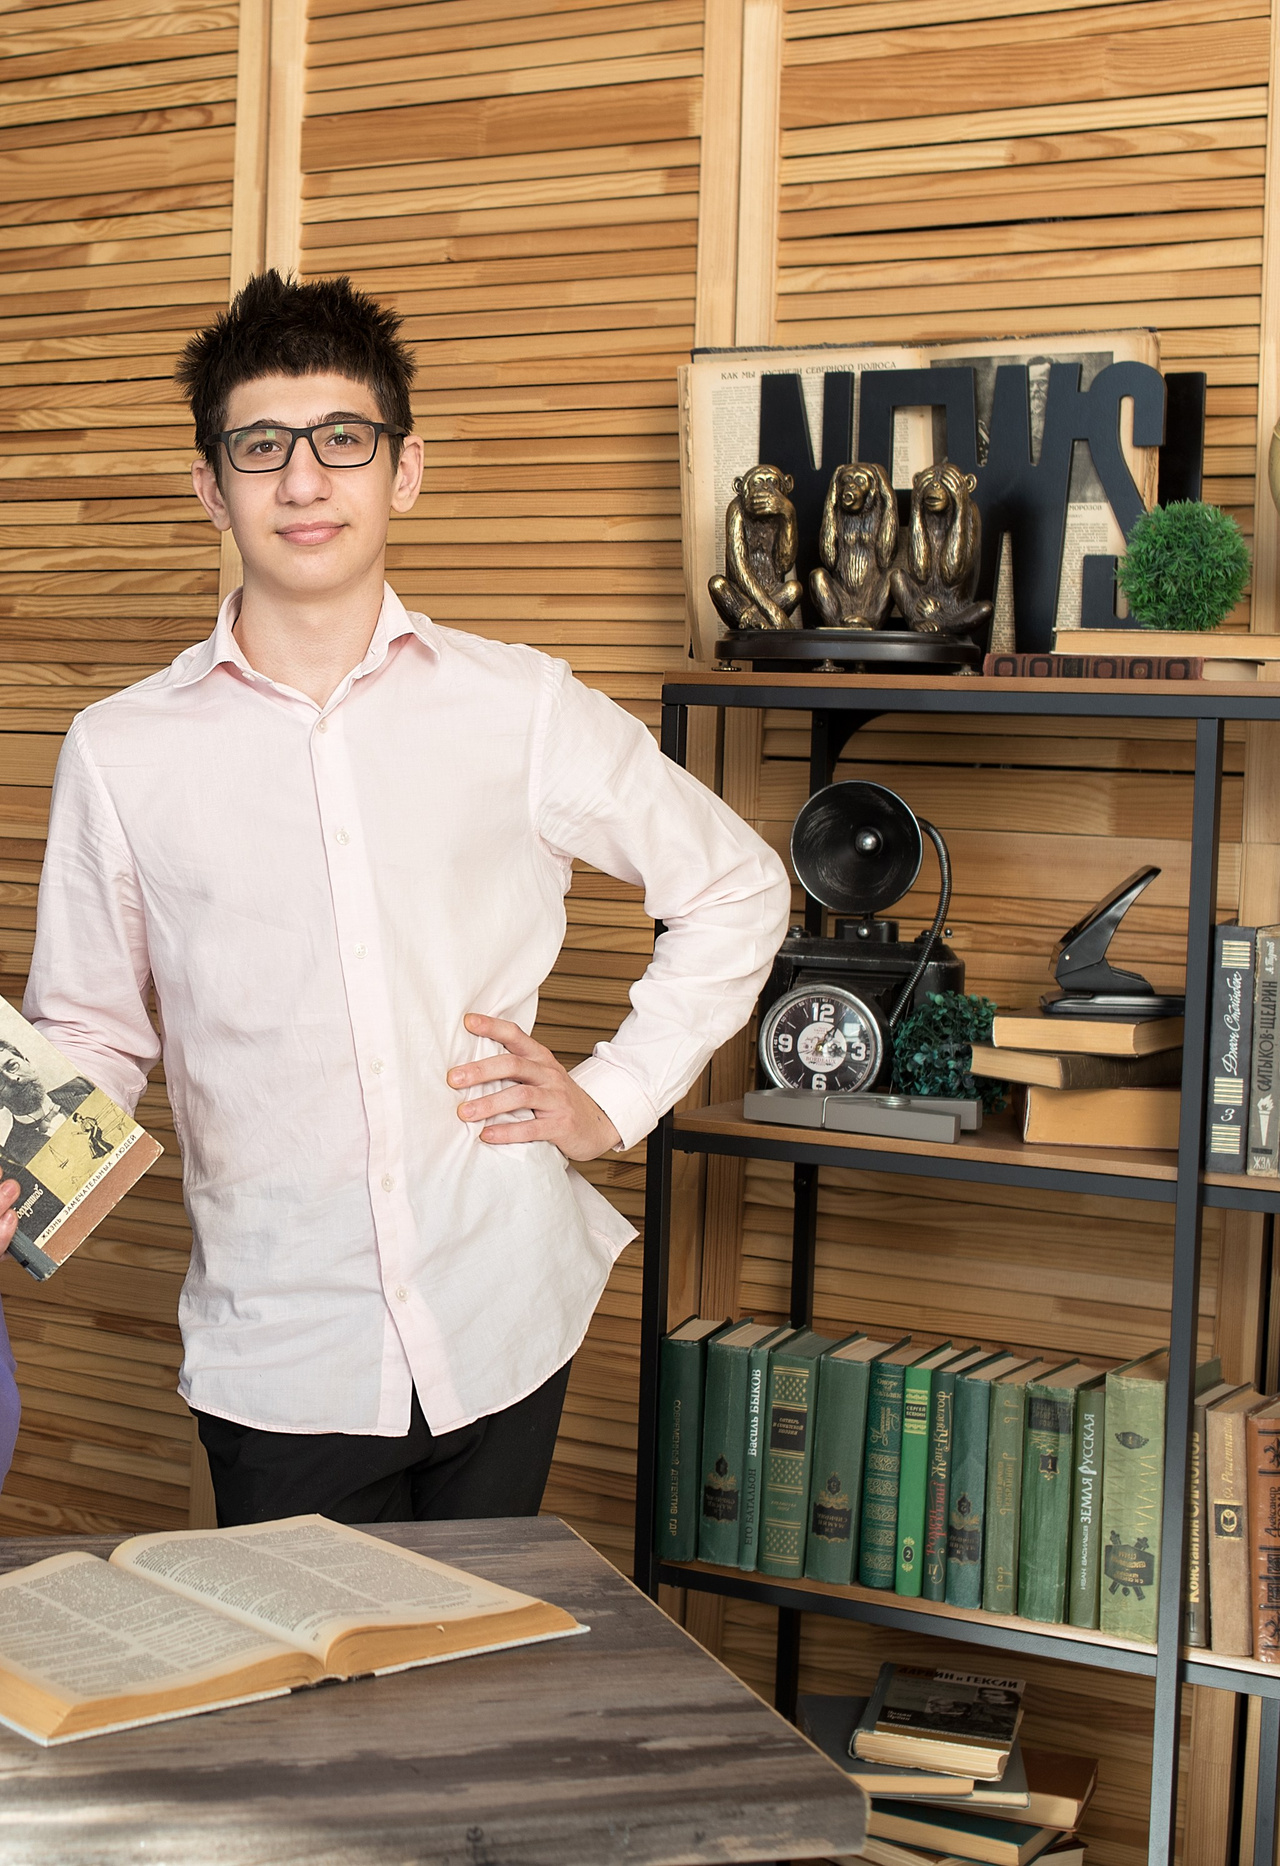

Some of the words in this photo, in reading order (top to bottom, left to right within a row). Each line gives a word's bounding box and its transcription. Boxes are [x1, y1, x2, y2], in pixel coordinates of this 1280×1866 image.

[721, 371, 738, 380] КАК
[741, 371, 756, 379] МЫ
[805, 364, 855, 373] СЕВЕРНОГО
[857, 361, 897, 371] ПОЛЮСА
[753, 361, 1167, 672] NEWS
[812, 1002, 835, 1023] 12
[1224, 971, 1242, 1031] Стейнбек
[778, 1033, 793, 1053] 9
[850, 1042, 867, 1061] 3
[1257, 981, 1278, 1091] САЛТЫКОВ-ЩЕДРИН
[812, 1073, 827, 1091] 6
[1221, 1108, 1235, 1121] 3
[1253, 1156, 1271, 1169] ЖЗЛ
[41, 1217, 63, 1241] ЖИЗНЬ
[63, 1159, 115, 1217] ЗАМЕЧАТЕЛЬНЫХ
[115, 1133, 139, 1162] ЛЮДЕЙ
[749, 1368, 762, 1414] БЫКОВ
[672, 1399, 681, 1465] СОВРЕМЕННЫЙ
[747, 1415, 759, 1457] Василь
[931, 1390, 950, 1480] Жан-Кристоф
[1078, 1413, 1097, 1476] РУССКАЯ
[1047, 1459, 1052, 1469] 1
[670, 1469, 680, 1515] ДЕТЕКТИВ
[746, 1468, 757, 1525] БАТАЛЬОН
[1080, 1478, 1093, 1524] ЗЕМЛЯ
[669, 1518, 678, 1537] ГДР
[745, 1527, 753, 1546] ЕГО
[905, 1550, 911, 1558] 2
[1188, 1520, 1199, 1603] Константин
[966, 1676, 1019, 1689] ГЕКСЛИ
